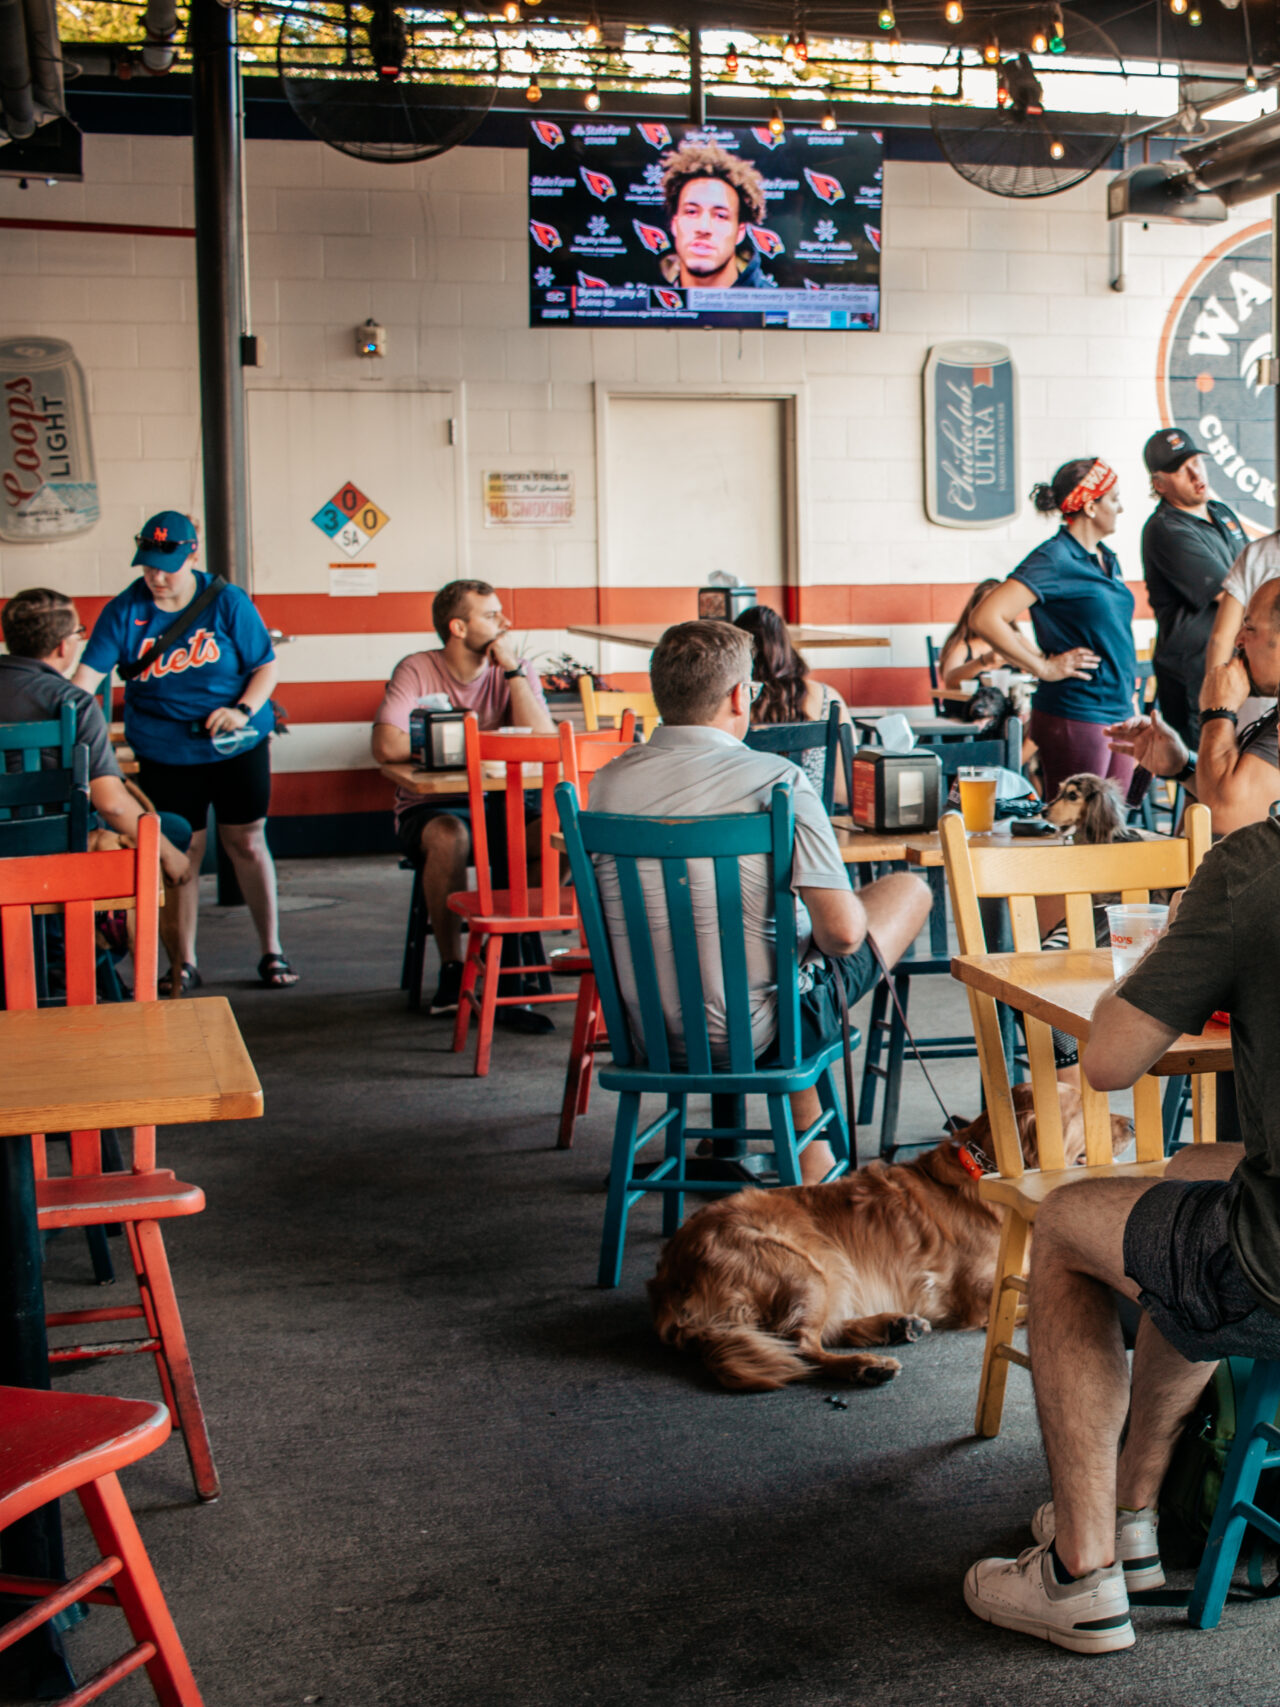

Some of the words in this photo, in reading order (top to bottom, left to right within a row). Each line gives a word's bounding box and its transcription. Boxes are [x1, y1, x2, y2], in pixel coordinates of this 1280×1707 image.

[42, 396, 72, 477] LIGHT
[974, 405, 996, 486] ULTRA
[1199, 414, 1278, 508] CHICK
[341, 489, 357, 511] 0
[489, 501, 508, 519] NO
[511, 501, 573, 518] SMOKING
[323, 509, 339, 531] 3
[362, 508, 378, 530] 0
[342, 531, 360, 547] SA
